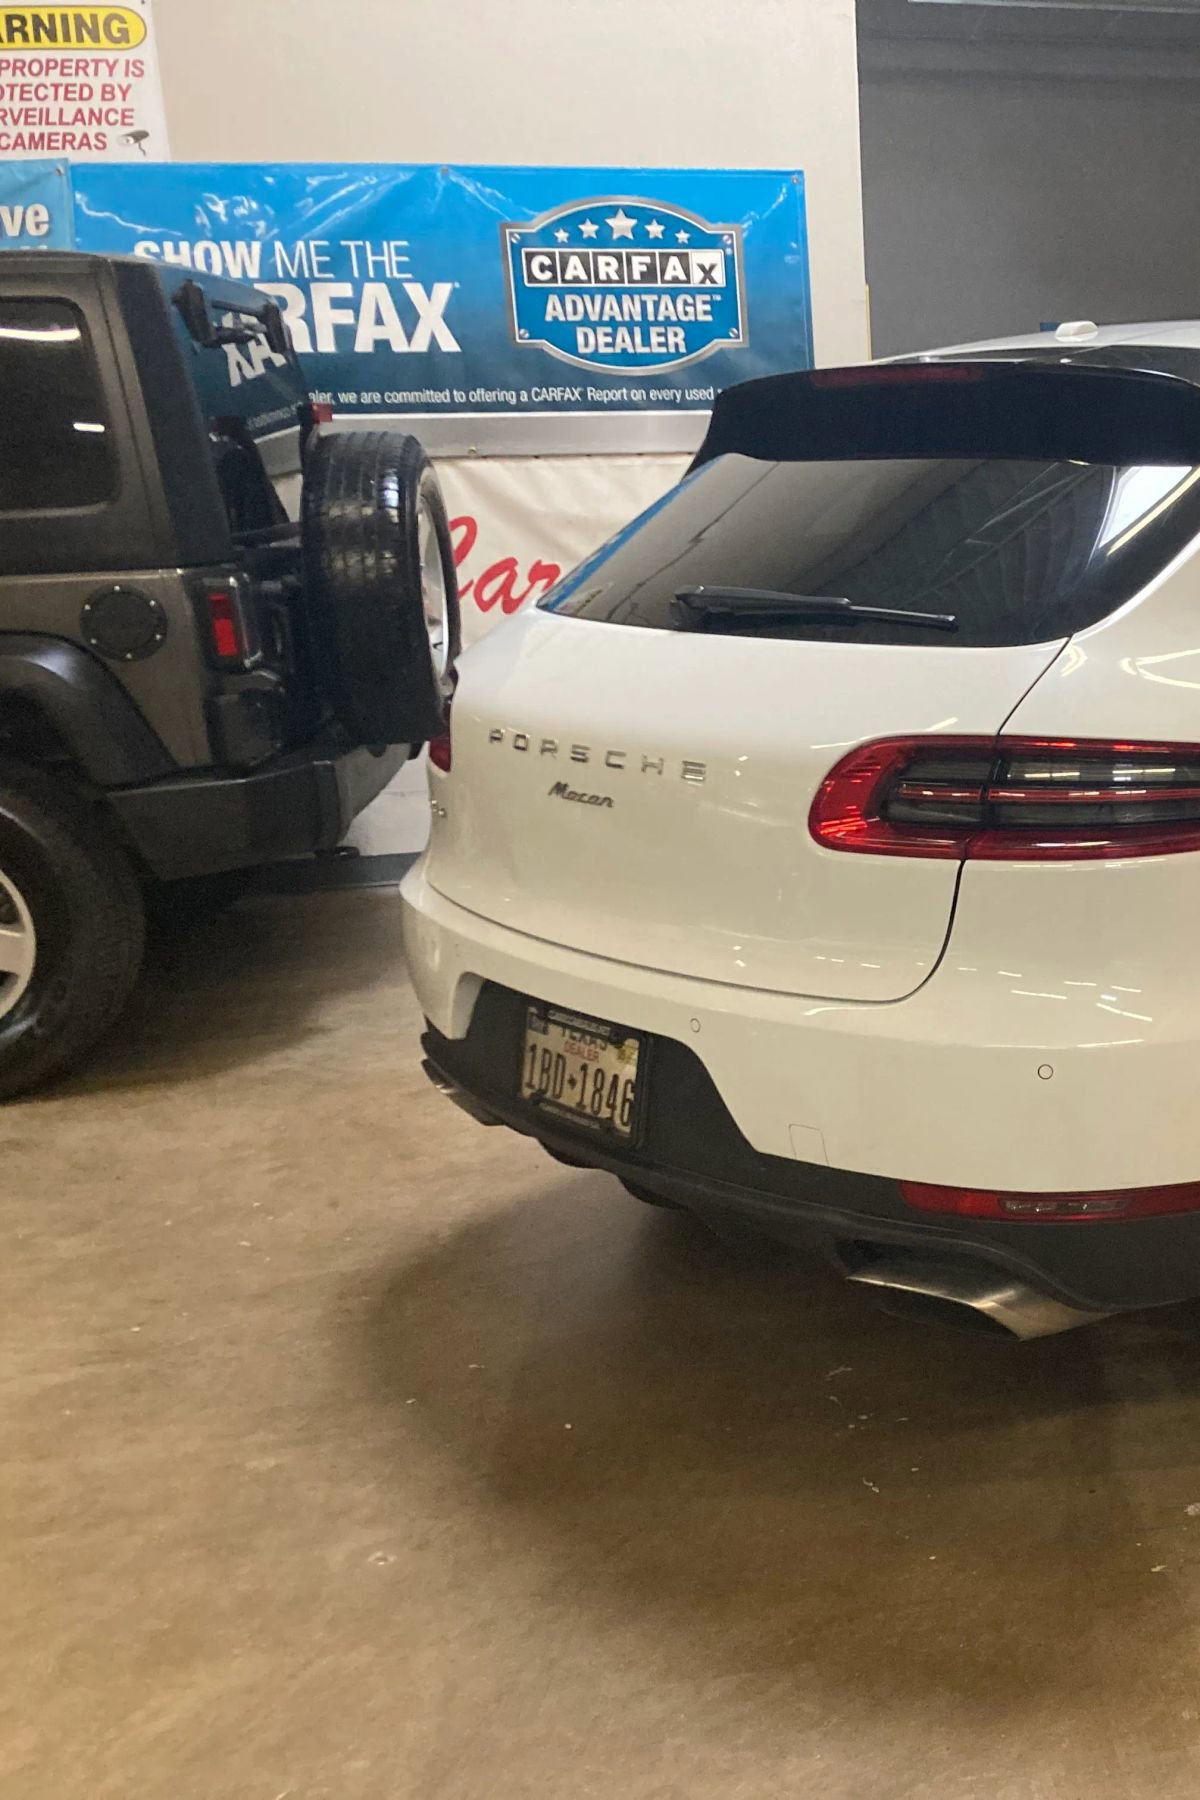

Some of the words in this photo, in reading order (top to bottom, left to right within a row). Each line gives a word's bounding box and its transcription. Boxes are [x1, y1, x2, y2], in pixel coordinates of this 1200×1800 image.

[0, 13, 130, 44] RNING
[0, 58, 118, 77] PROPERTY
[125, 59, 145, 78] IS
[101, 83, 132, 102] BY
[0, 132, 107, 151] CAMERAS
[0, 203, 49, 237] ve
[275, 240, 335, 279] ME
[341, 240, 414, 279] THE
[530, 253, 719, 285] CARFAX
[576, 326, 687, 354] DEALER
[338, 392, 357, 404] we
[360, 392, 381, 404] are
[384, 388, 451, 404] committed
[453, 388, 466, 403] to
[468, 387, 516, 405] offering
[520, 391, 528, 402] a
[587, 386, 627, 404] Report
[630, 389, 646, 401] on
[650, 389, 681, 404] every
[685, 386, 714, 401] used
[488, 727, 707, 786] PORSCHE
[548, 780, 615, 808] Macan
